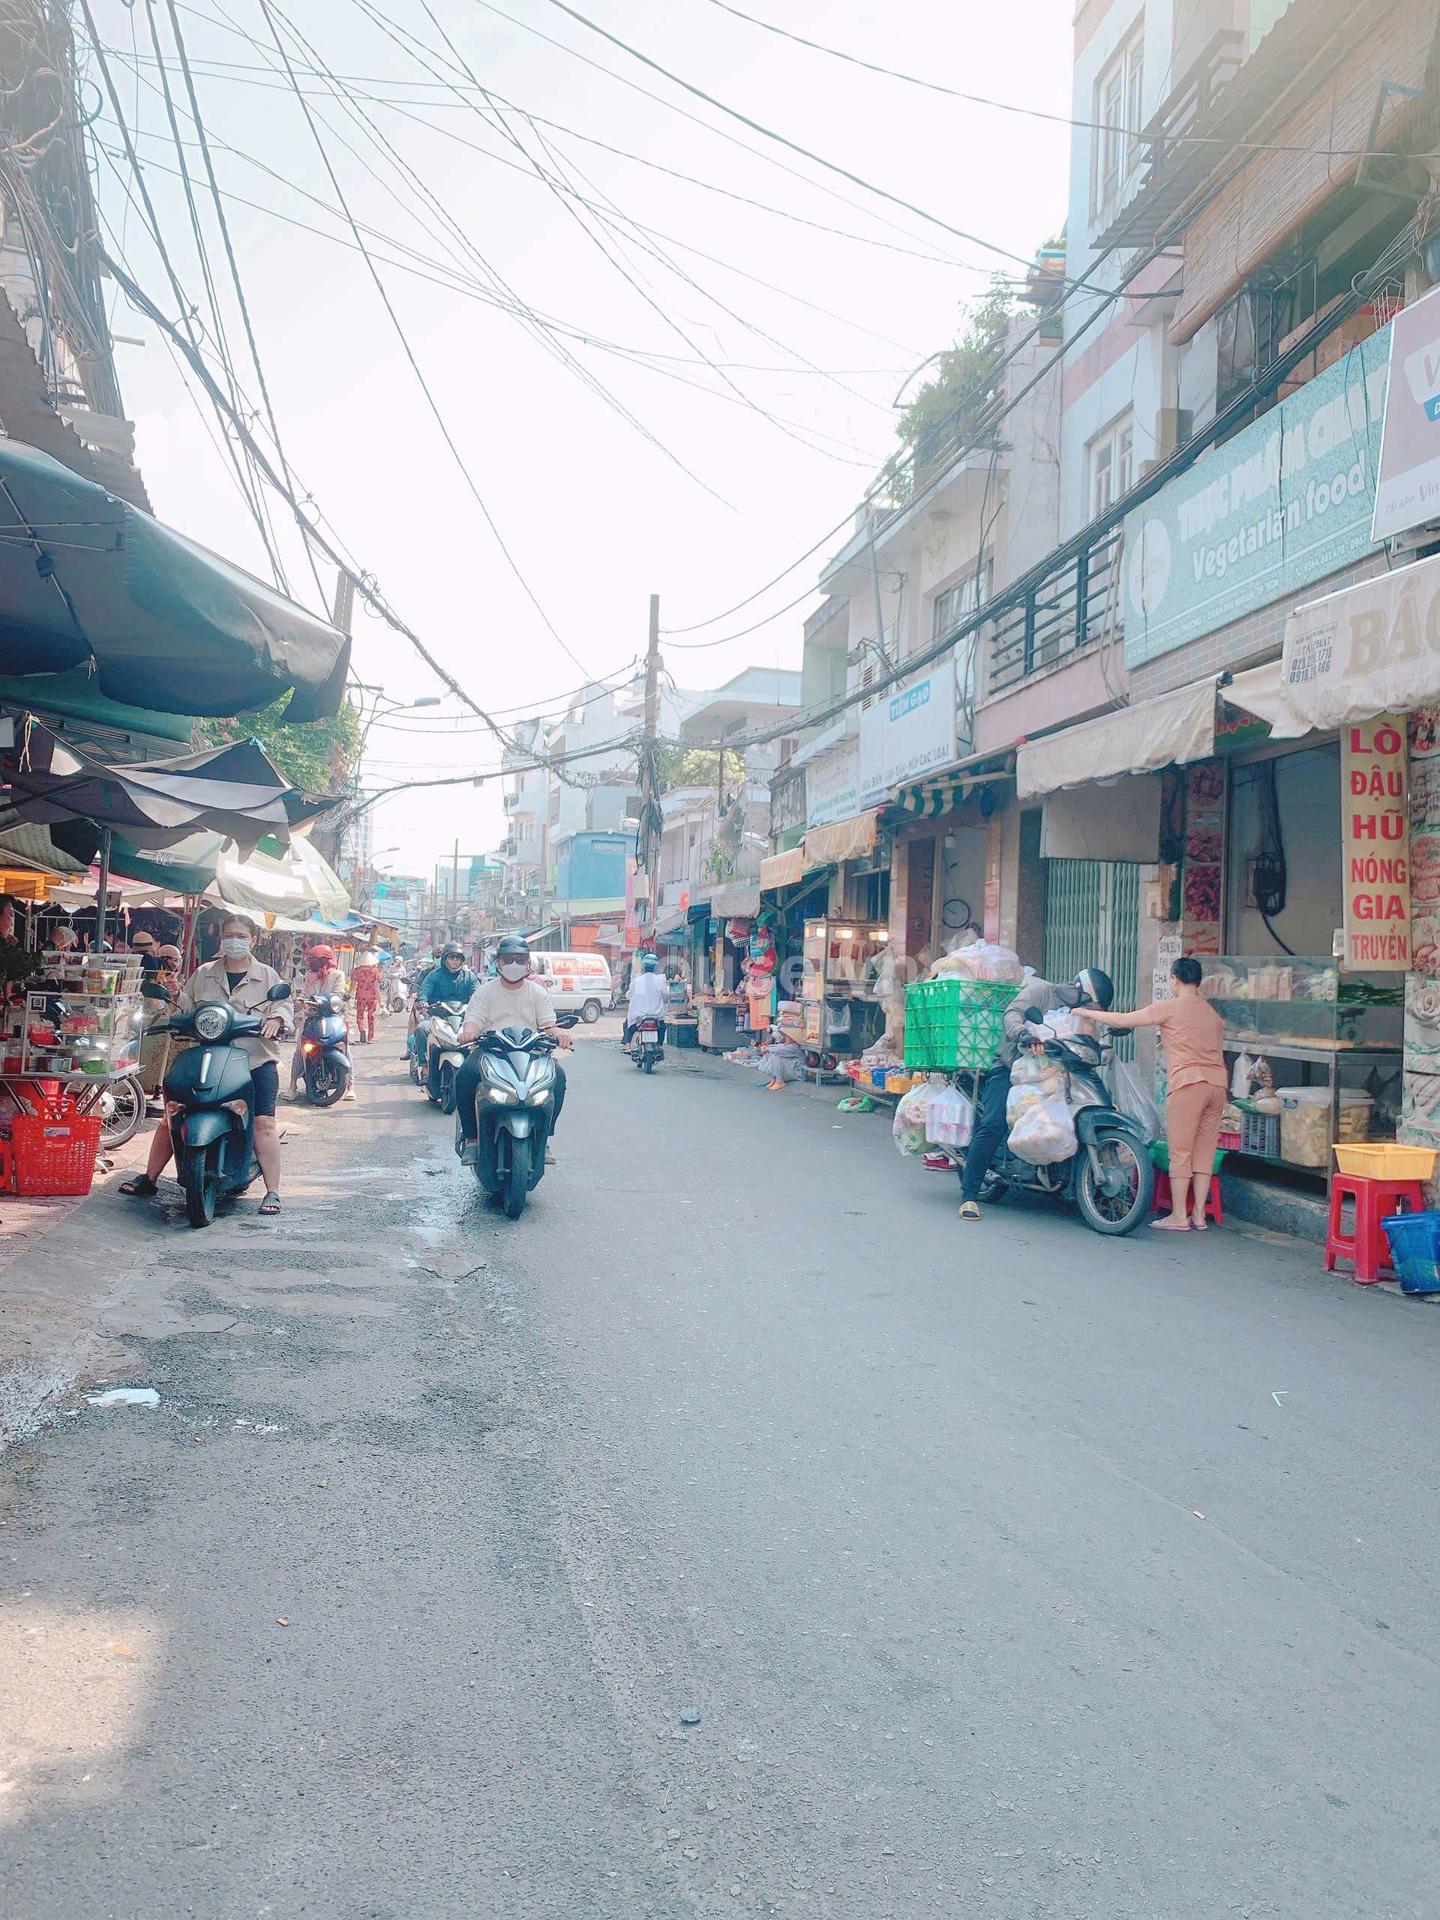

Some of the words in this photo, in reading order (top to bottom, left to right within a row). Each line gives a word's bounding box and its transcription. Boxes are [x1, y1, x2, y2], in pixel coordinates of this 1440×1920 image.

[1191, 500, 1301, 583] Vegetarian
[1306, 451, 1367, 527] food
[1350, 722, 1403, 755] LÒ
[1350, 764, 1403, 802] ĐẬU
[1352, 808, 1404, 841] HŨ
[1351, 852, 1406, 884] NÓNG
[1352, 894, 1406, 920] GIA
[1351, 924, 1407, 962] TRUYỀN
